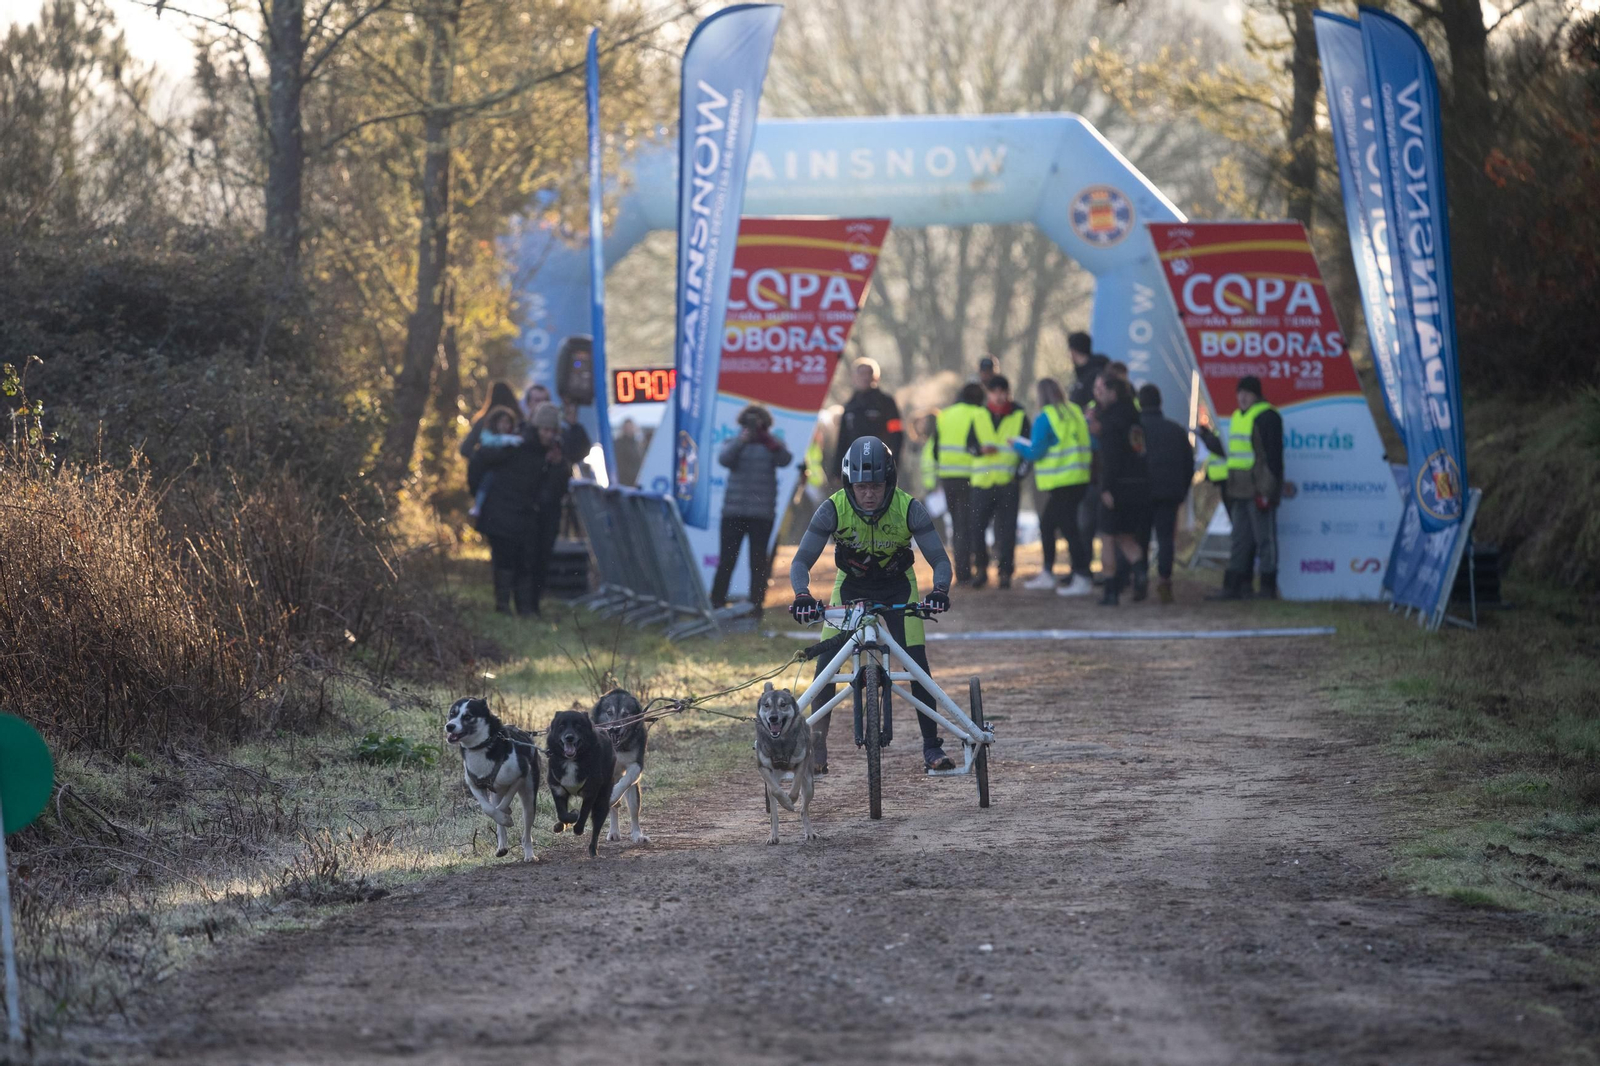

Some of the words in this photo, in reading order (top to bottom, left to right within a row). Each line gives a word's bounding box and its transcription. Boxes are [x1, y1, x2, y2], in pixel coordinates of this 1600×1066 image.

[725, 88, 744, 149] INVIERNO
[746, 145, 1007, 181] AINSNOW
[680, 79, 728, 411] SPAINSNOW
[727, 268, 857, 310] COPA
[1182, 273, 1322, 316] COPA
[721, 324, 846, 353] OBORÁS
[1200, 328, 1344, 358] BOBORÁS
[769, 355, 827, 374] 21-22
[1268, 360, 1324, 379] 21-22
